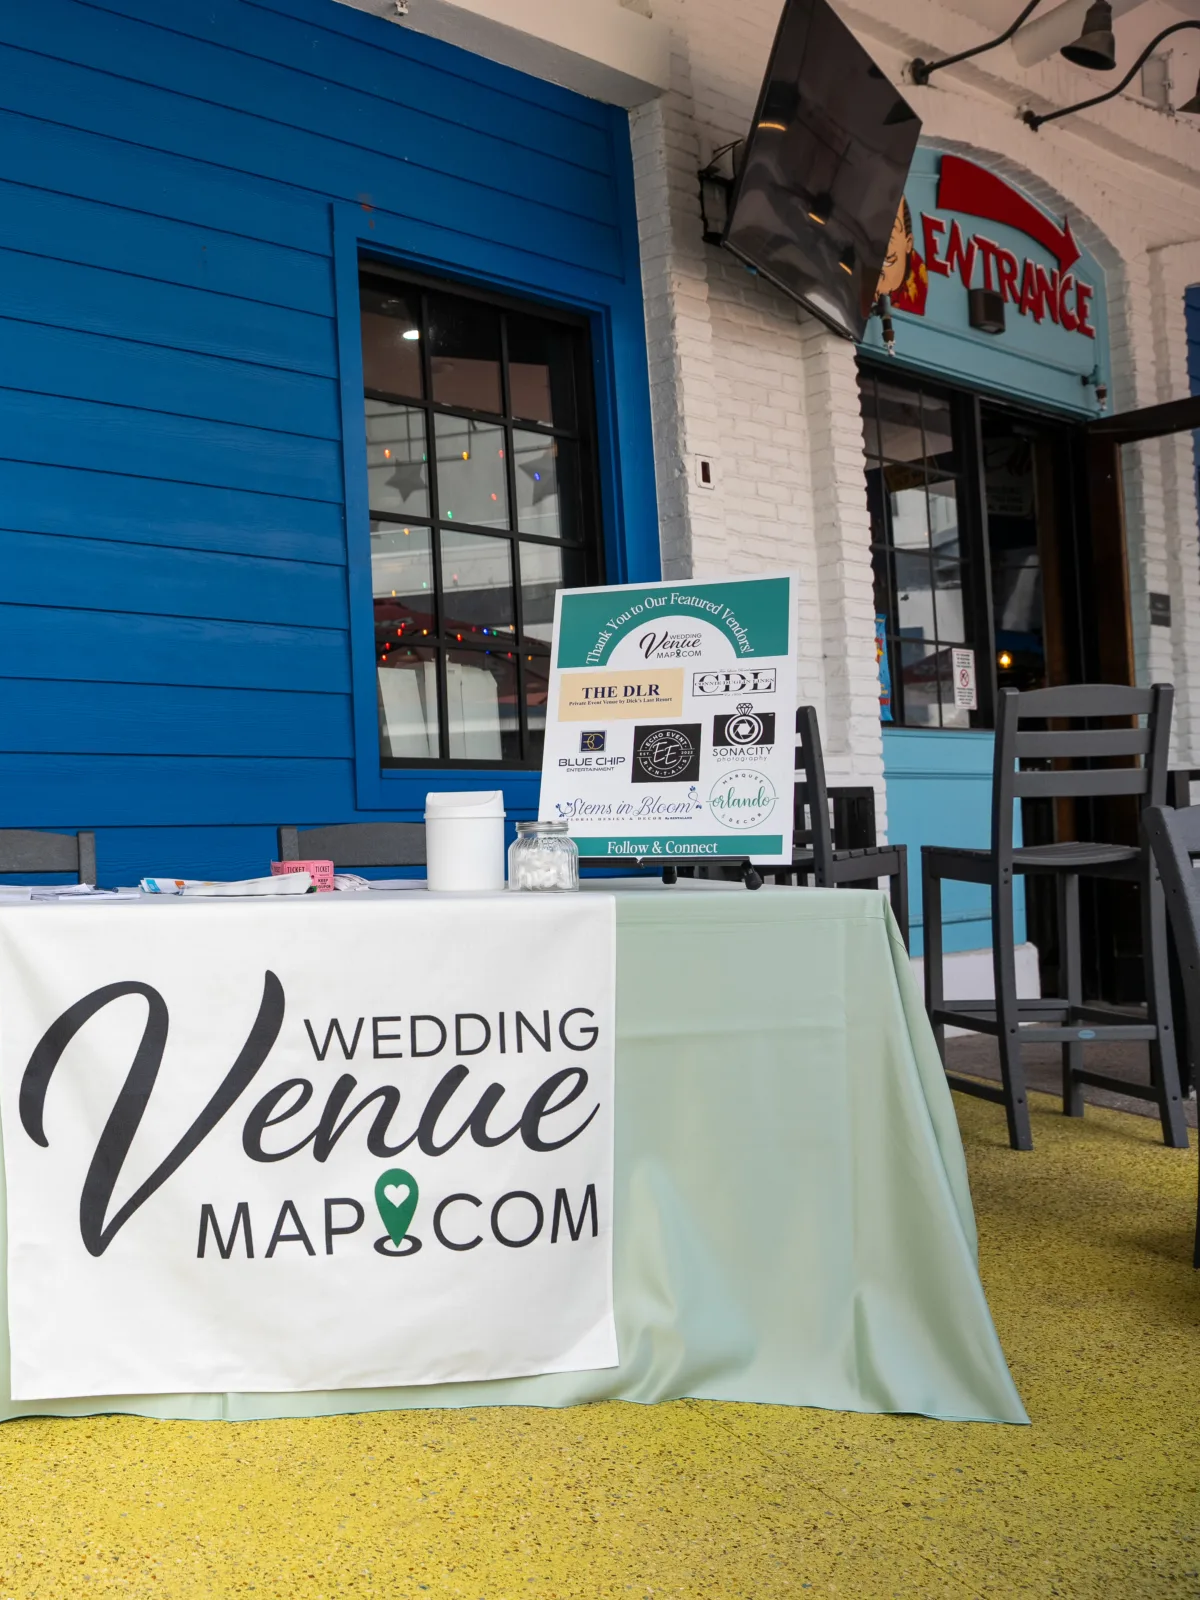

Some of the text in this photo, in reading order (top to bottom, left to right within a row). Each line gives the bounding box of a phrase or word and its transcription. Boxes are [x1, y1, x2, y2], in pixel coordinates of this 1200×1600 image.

[920, 211, 1095, 339] ENTRANCE
[586, 592, 755, 665] Thank You to Our Featured Vendors!
[639, 631, 702, 660] Venue
[582, 684, 660, 699] THE DLR
[698, 672, 772, 694] CDL
[645, 731, 688, 747] ECHO EVENT
[558, 756, 626, 767] BLUE CHIP
[712, 746, 773, 757] SONACITY
[566, 796, 692, 817] Stems in Bloom
[711, 786, 770, 809] orlando
[607, 840, 718, 854] Follow & Connect
[303, 1007, 599, 1061] WEDDING
[18, 969, 601, 1258] Venue
[196, 1198, 365, 1259] MAP
